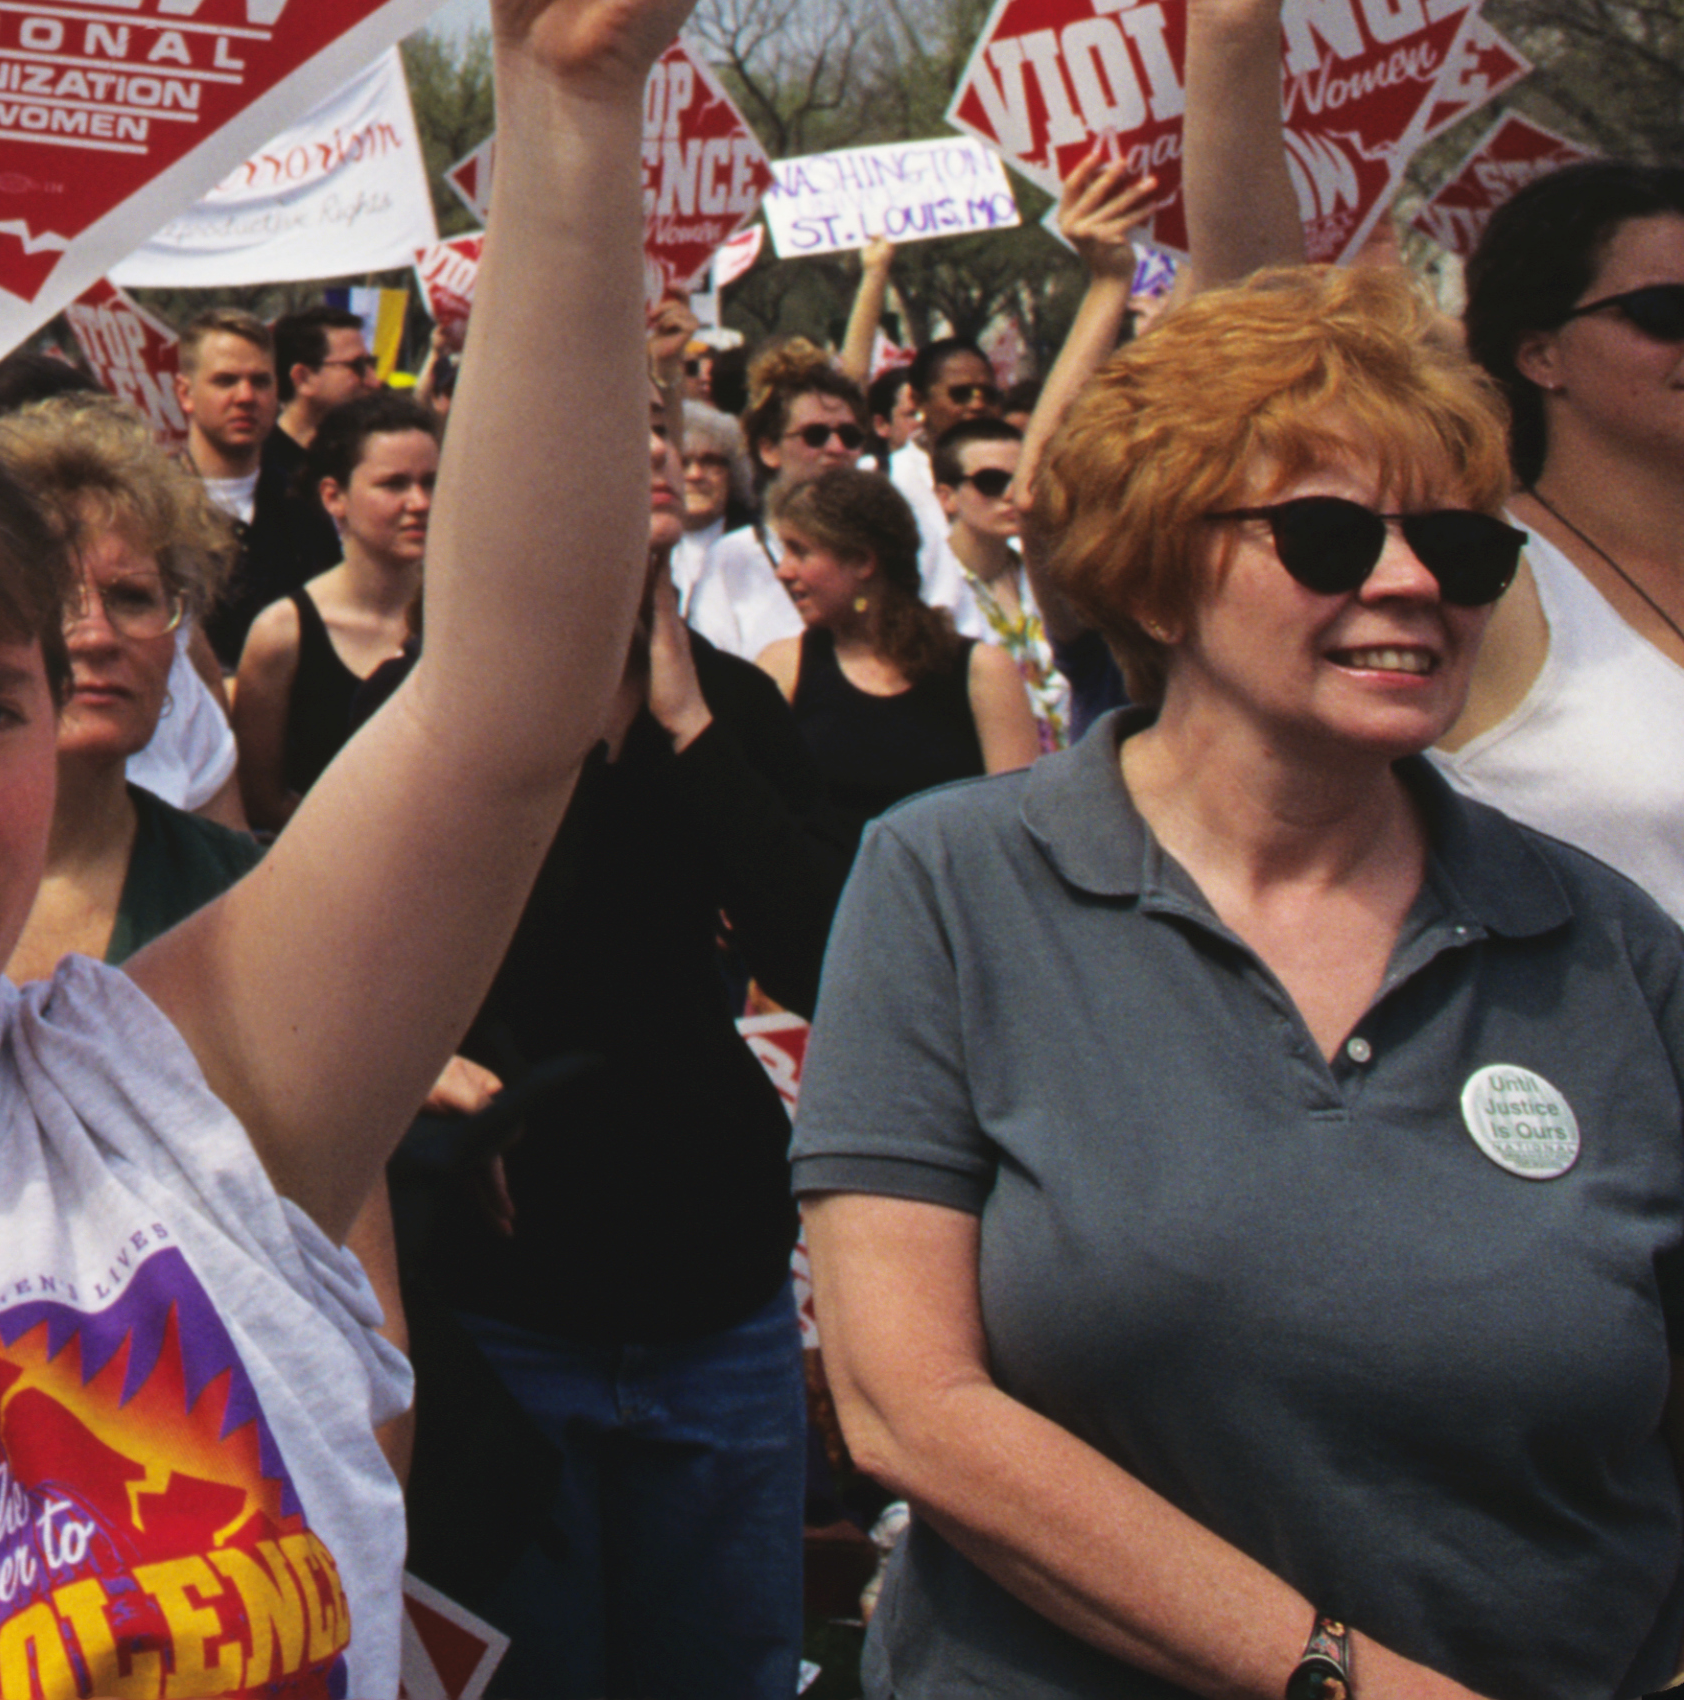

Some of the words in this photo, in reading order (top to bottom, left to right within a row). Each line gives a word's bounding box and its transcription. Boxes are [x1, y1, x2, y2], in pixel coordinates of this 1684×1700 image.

[1487, 1074, 1540, 1092] Until
[1484, 1097, 1560, 1116] Justice
[1489, 1121, 1510, 1139] Is
[1515, 1121, 1568, 1141] Ours
[94, 1222, 170, 1299] LIVES
[36, 1498, 97, 1569] to
